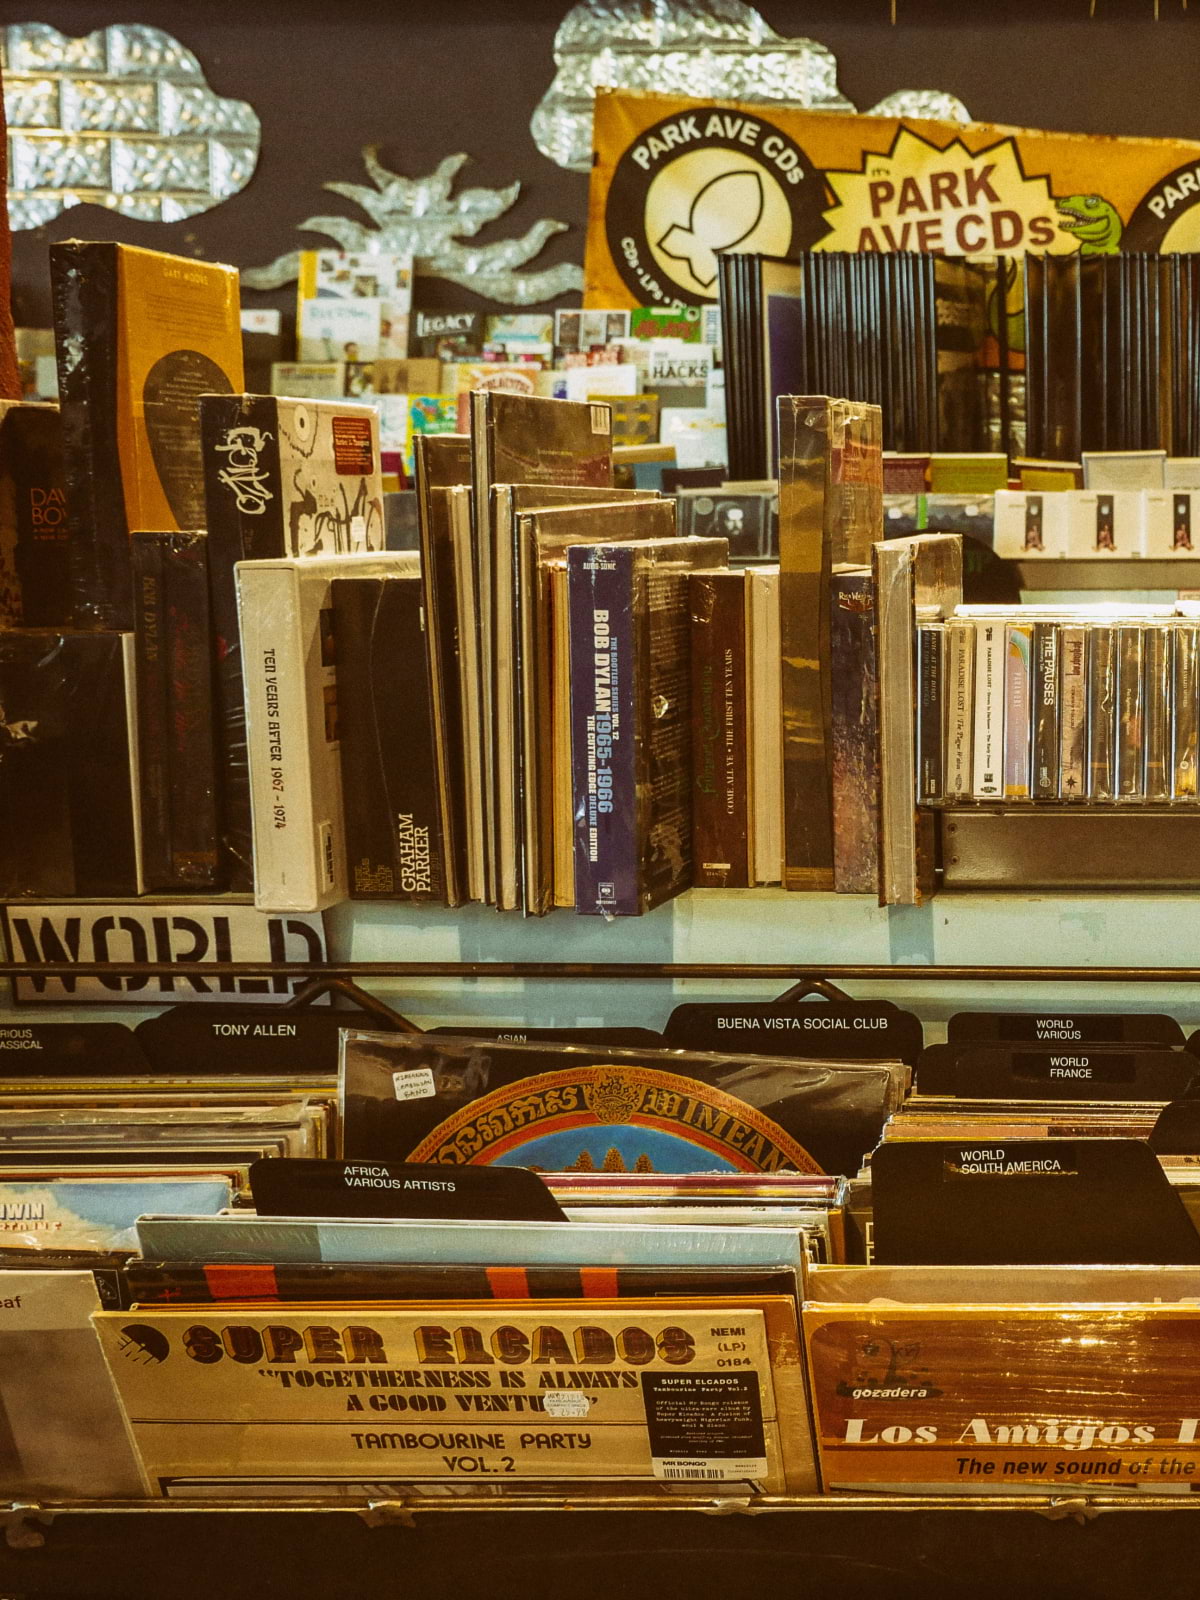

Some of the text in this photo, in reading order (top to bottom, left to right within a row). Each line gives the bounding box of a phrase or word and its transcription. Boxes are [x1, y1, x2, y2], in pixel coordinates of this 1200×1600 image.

[633, 115, 806, 185] PARK AVE CDs
[868, 165, 998, 218] PARK
[859, 212, 1057, 253] AVE CDs
[417, 312, 475, 336] LEGACY
[653, 365, 708, 378] HACKS
[724, 649, 733, 677] YEARS
[1044, 635, 1053, 706] THE PAUSES
[593, 610, 613, 813] BOB DYLAN 1965-1966
[726, 699, 734, 726] FIRST
[726, 728, 734, 745] THE
[587, 715, 597, 861] THE CUTTING EDGE DELUXE EDITION
[727, 788, 735, 814] COME
[399, 813, 414, 892] GRAHAM
[416, 826, 431, 892] PARKER
[12, 916, 323, 994] WORLD
[212, 1024, 296, 1036] TONY ALLEN
[717, 1018, 888, 1030] BUENA VISTA SOCIAL CLUB
[1036, 1019, 1074, 1029] WORLD
[1036, 1029, 1081, 1040] VARIOUS
[1050, 1057, 1089, 1068] WORLD
[1050, 1068, 1093, 1079] FRANCE
[960, 1149, 1005, 1162] WORLD
[344, 1166, 389, 1177] AFRICA
[1005, 1160, 1061, 1173] AMERICA
[344, 1178, 457, 1192] VARIOUS ARTISTS
[710, 1327, 745, 1337] NEMI
[181, 1324, 698, 1366] SUPER ELCADOS
[718, 1341, 746, 1352] (LP)
[717, 1357, 751, 1367] 0184
[500, 1370, 639, 1389] IS ALWAYS
[852, 1386, 929, 1400] gozadera
[346, 1394, 447, 1412] A GOOD
[351, 1432, 592, 1450] TAMBOURINE PARTY
[842, 1418, 938, 1444] Los
[960, 1418, 1157, 1451] Amigos
[956, 1457, 998, 1475] The
[1002, 1460, 1050, 1475] new
[1055, 1457, 1123, 1475] sound
[1128, 1457, 1155, 1475] of
[1159, 1457, 1199, 1474] the
